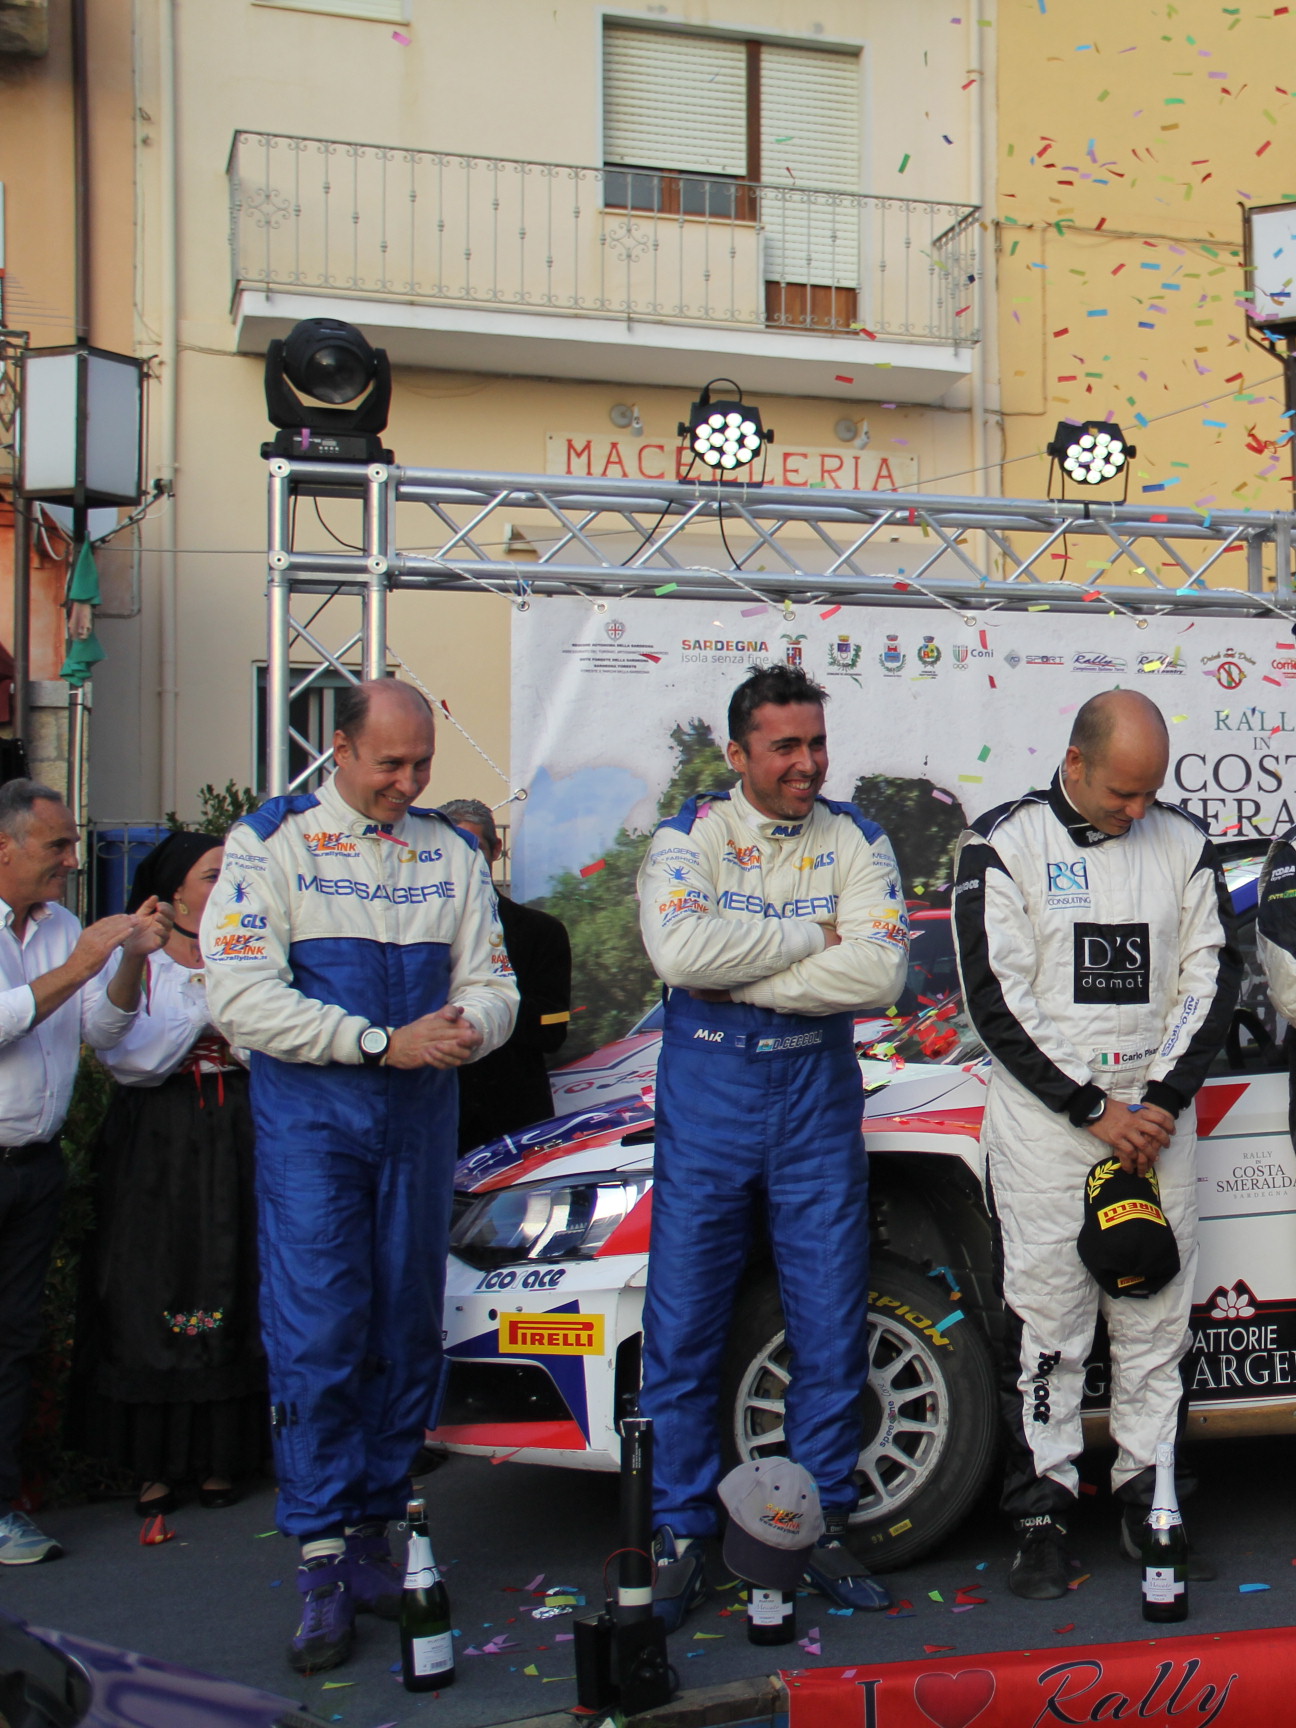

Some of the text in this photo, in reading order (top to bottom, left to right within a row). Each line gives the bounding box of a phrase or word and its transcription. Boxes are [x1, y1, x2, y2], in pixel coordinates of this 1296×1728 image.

[565, 438, 898, 494] MACELERIA
[681, 639, 769, 653] SARDEGNA
[971, 649, 994, 658] Coni
[681, 653, 769, 665] isola senza fine
[1026, 655, 1064, 663] SPORT
[1074, 654, 1113, 666] Rally
[1254, 737, 1271, 750] IN
[418, 848, 443, 863] GLS
[814, 851, 835, 871] GLS
[297, 873, 456, 905] MESSAGERIE
[1048, 896, 1092, 907] CONSULTING
[240, 913, 268, 930] GLS
[1081, 936, 1142, 969] D'S
[1082, 974, 1144, 990] damat
[1121, 1052, 1143, 1063] Carlo
[1242, 1151, 1273, 1161] RALLY
[1232, 1164, 1286, 1180] COSTA
[1233, 1189, 1289, 1200] SARDEGNA
[1103, 1201, 1164, 1225] PIRELLI
[508, 1320, 595, 1348] PIRELLI
[856, 1657, 1239, 1728] I Rally
